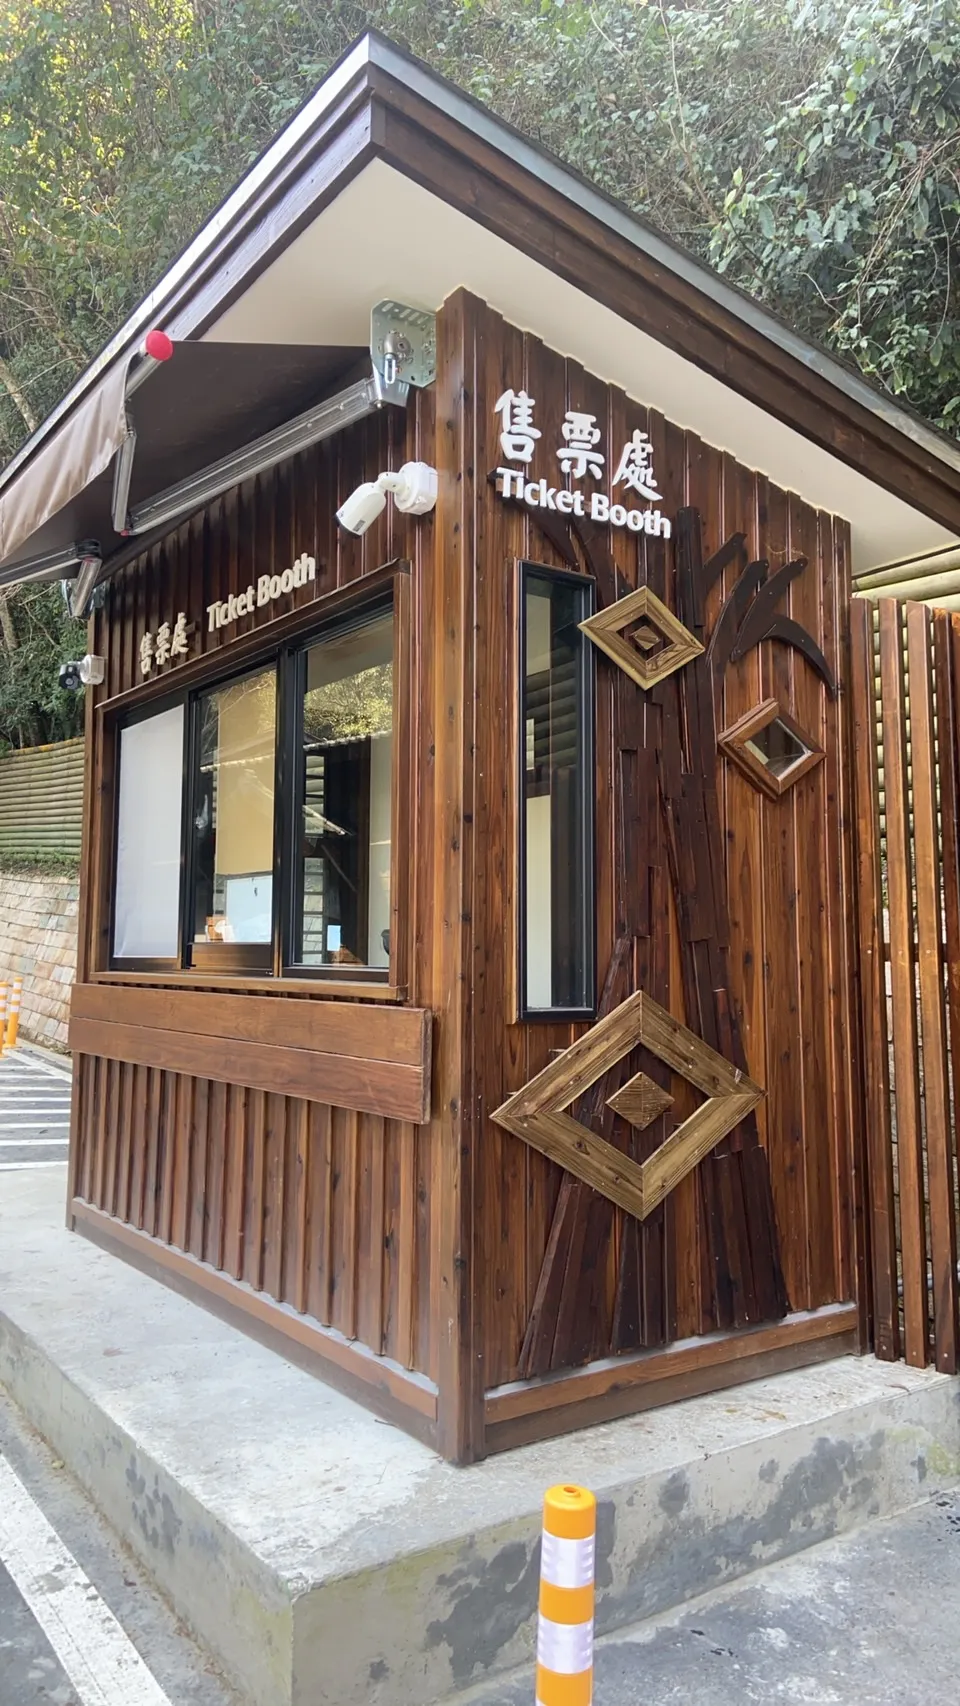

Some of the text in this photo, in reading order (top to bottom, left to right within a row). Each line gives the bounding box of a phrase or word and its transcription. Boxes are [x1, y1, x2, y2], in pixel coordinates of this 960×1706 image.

[495, 388, 663, 501] 售票處
[496, 467, 671, 539] Ticket Booth
[140, 552, 316, 675] 售票處 Ticket Booth
